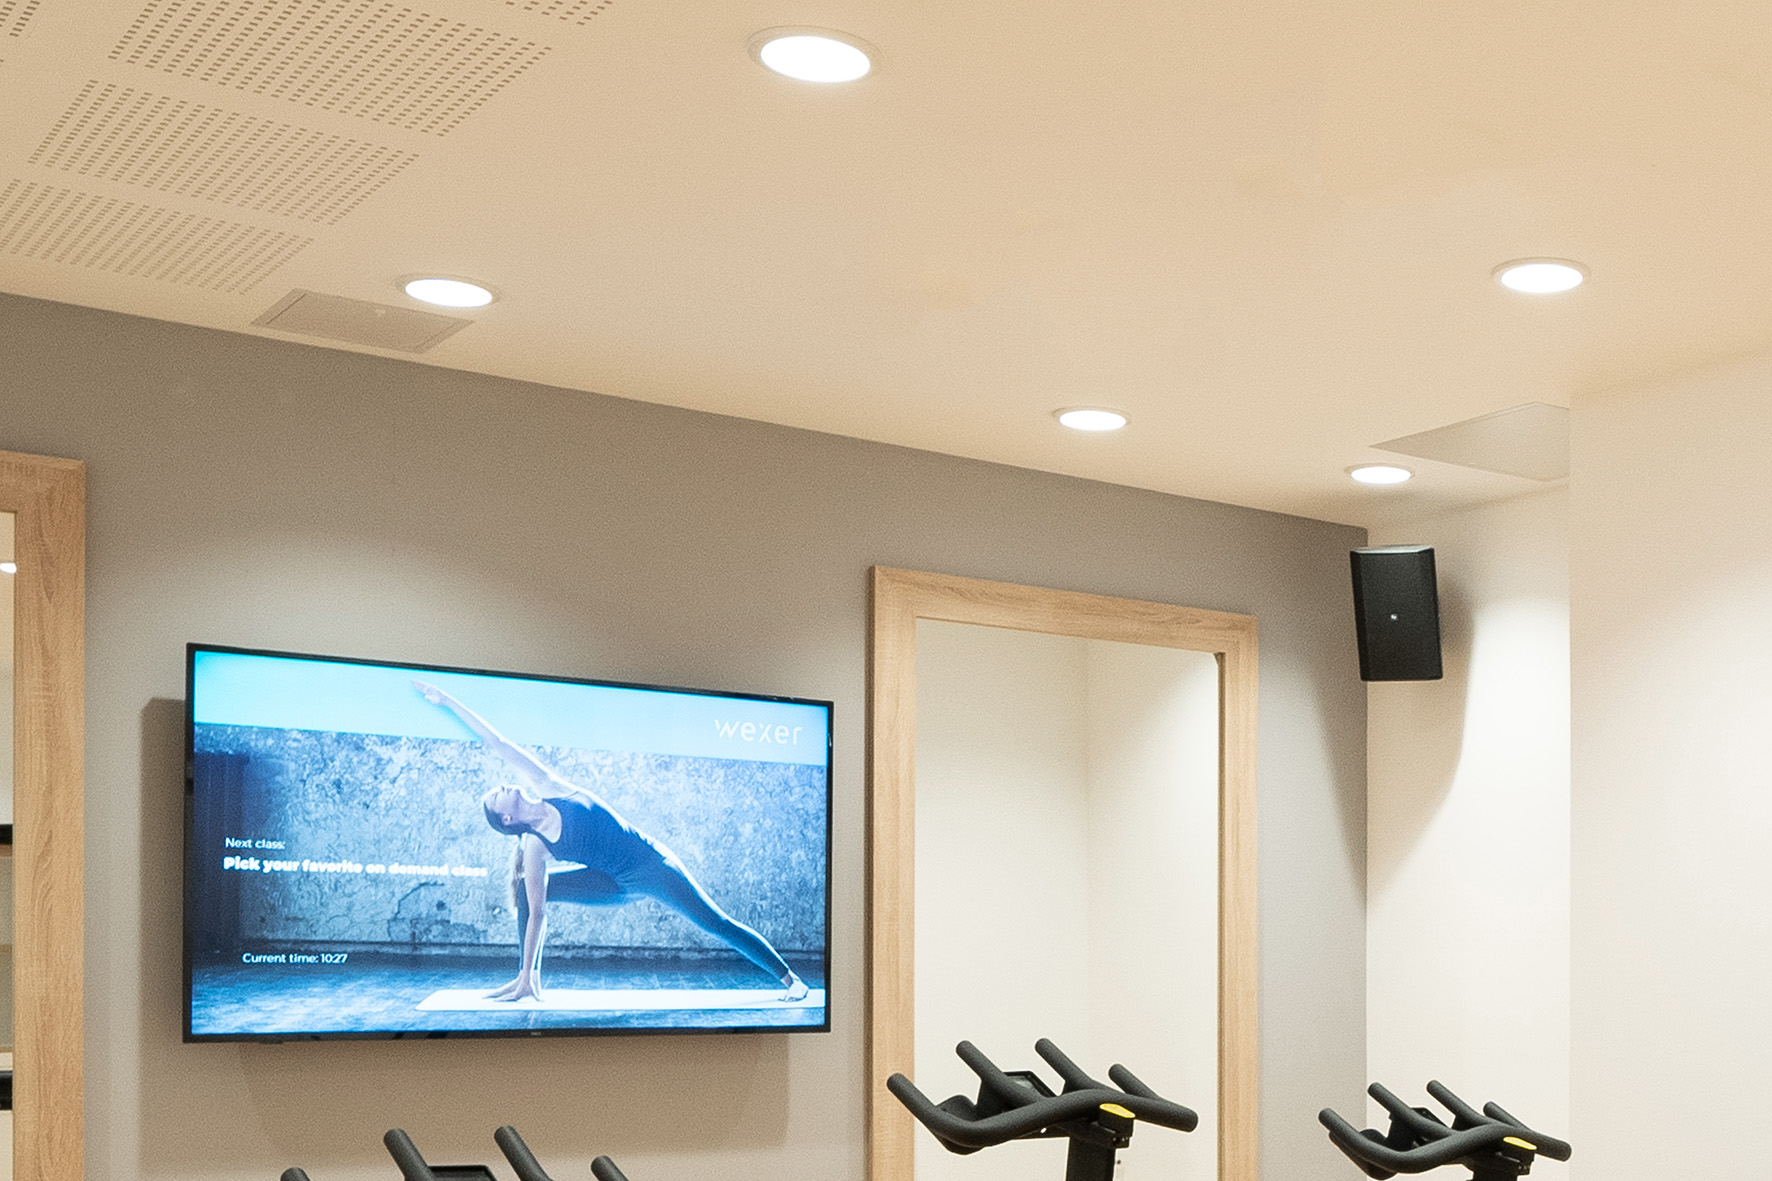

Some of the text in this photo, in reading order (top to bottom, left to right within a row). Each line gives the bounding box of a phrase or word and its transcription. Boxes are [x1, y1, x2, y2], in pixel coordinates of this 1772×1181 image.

[714, 719, 803, 745] wexer
[225, 838, 252, 848] Next
[223, 856, 488, 877] Pick your favorite on demand class
[242, 953, 286, 963] Current
[289, 954, 319, 963] time:
